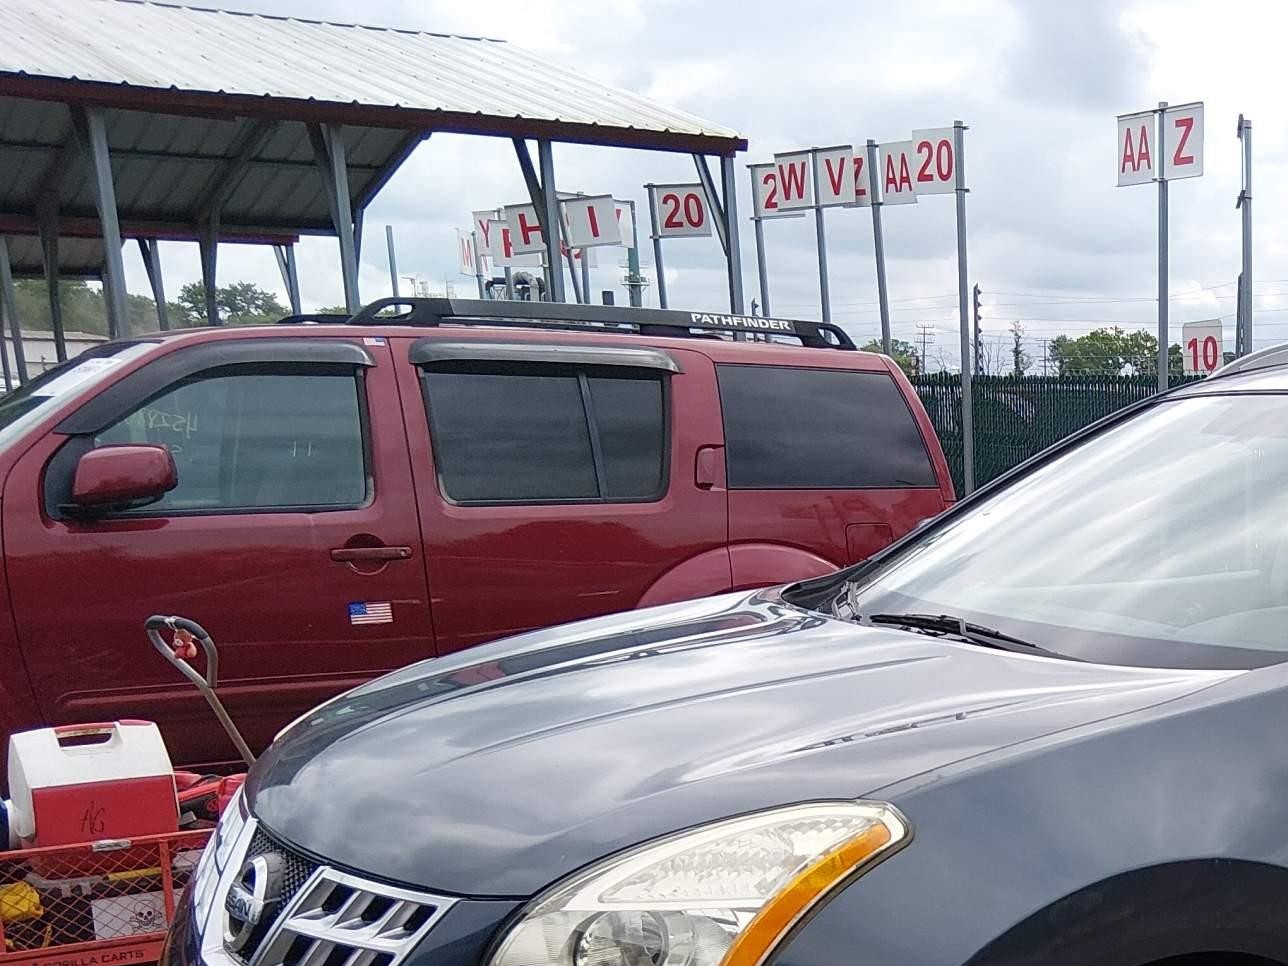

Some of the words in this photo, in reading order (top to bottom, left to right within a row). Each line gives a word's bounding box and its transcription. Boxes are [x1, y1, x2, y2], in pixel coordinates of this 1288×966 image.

[917, 139, 953, 182] 20
[1121, 125, 1152, 173] AA
[1173, 117, 1194, 166] Z
[778, 161, 806, 200] W
[825, 157, 845, 196] V
[885, 152, 913, 193] AA
[662, 193, 704, 229] 20
[690, 312, 792, 331] PATHFINDER
[1187, 335, 1219, 372] 10
[101, 950, 144, 964] CARTS
